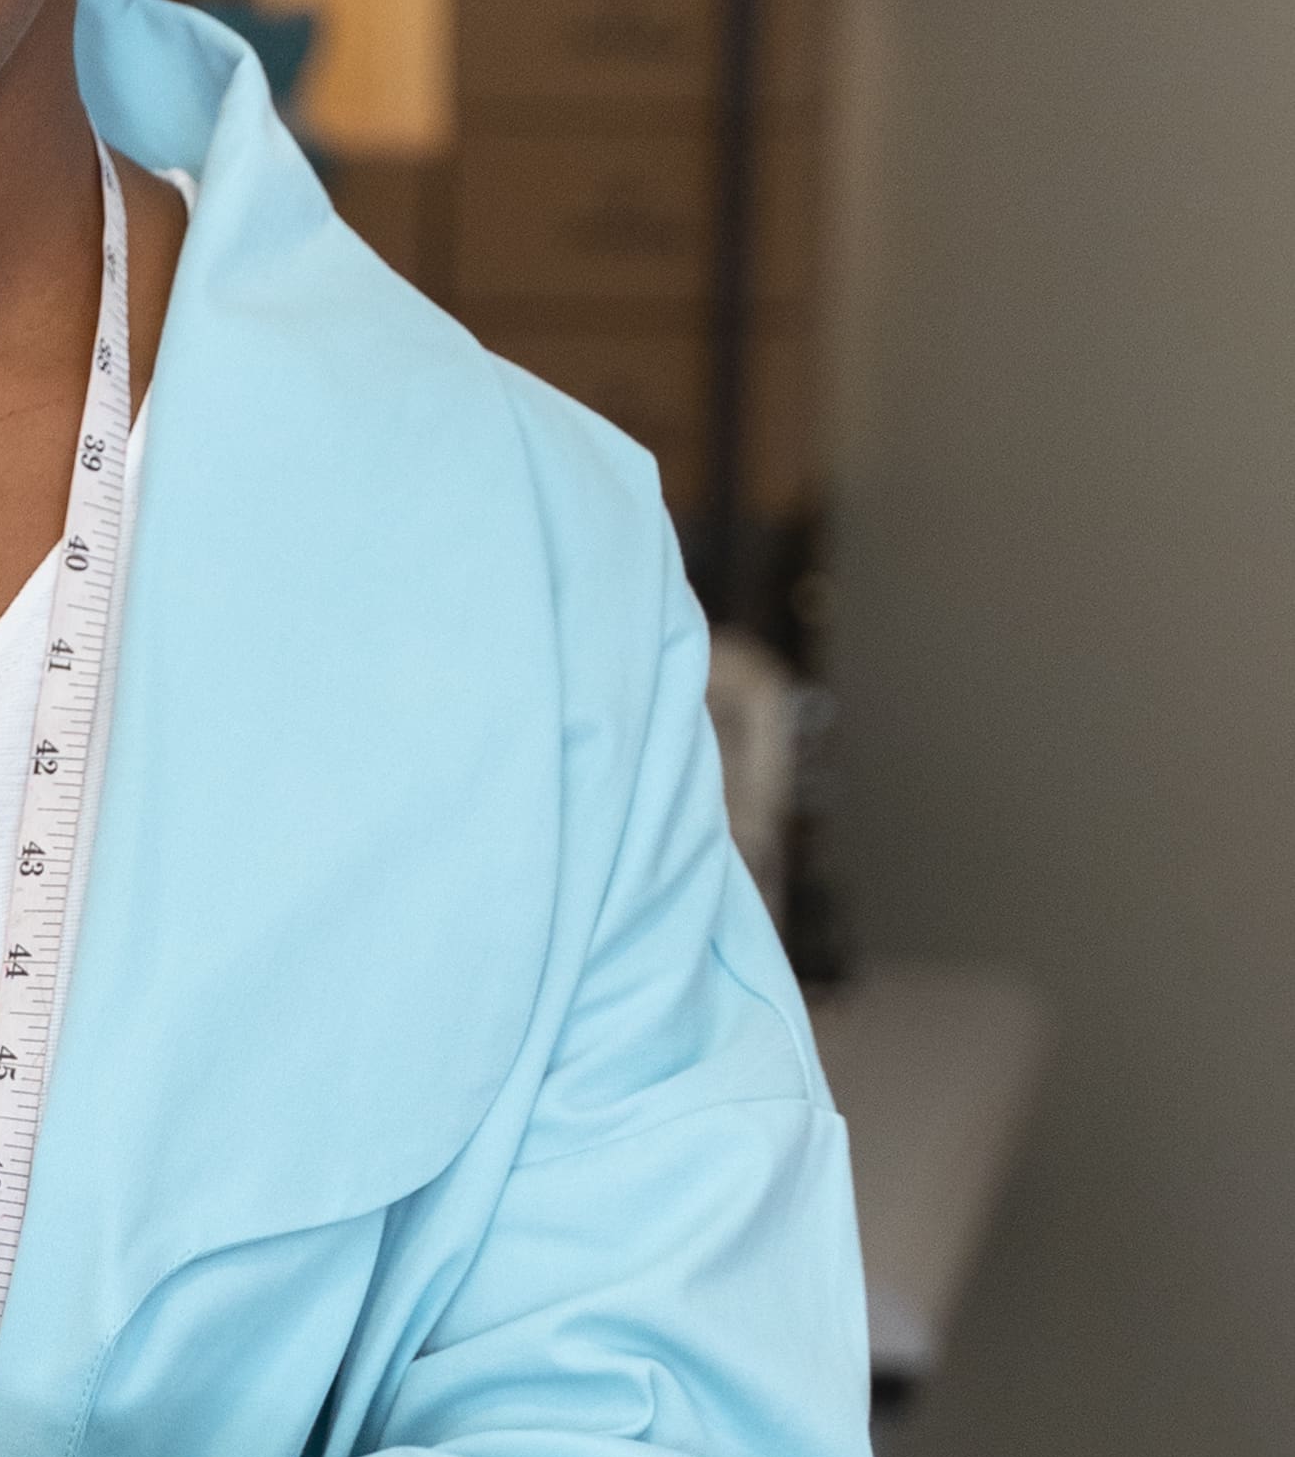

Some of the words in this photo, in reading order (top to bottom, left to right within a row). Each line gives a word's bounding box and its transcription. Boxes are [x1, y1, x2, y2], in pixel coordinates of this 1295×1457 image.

[82, 434, 105, 471] 39
[65, 534, 89, 572] 40
[49, 638, 74, 671] 41
[33, 739, 58, 775] 42
[20, 841, 44, 877] 43
[6, 945, 32, 978] 44
